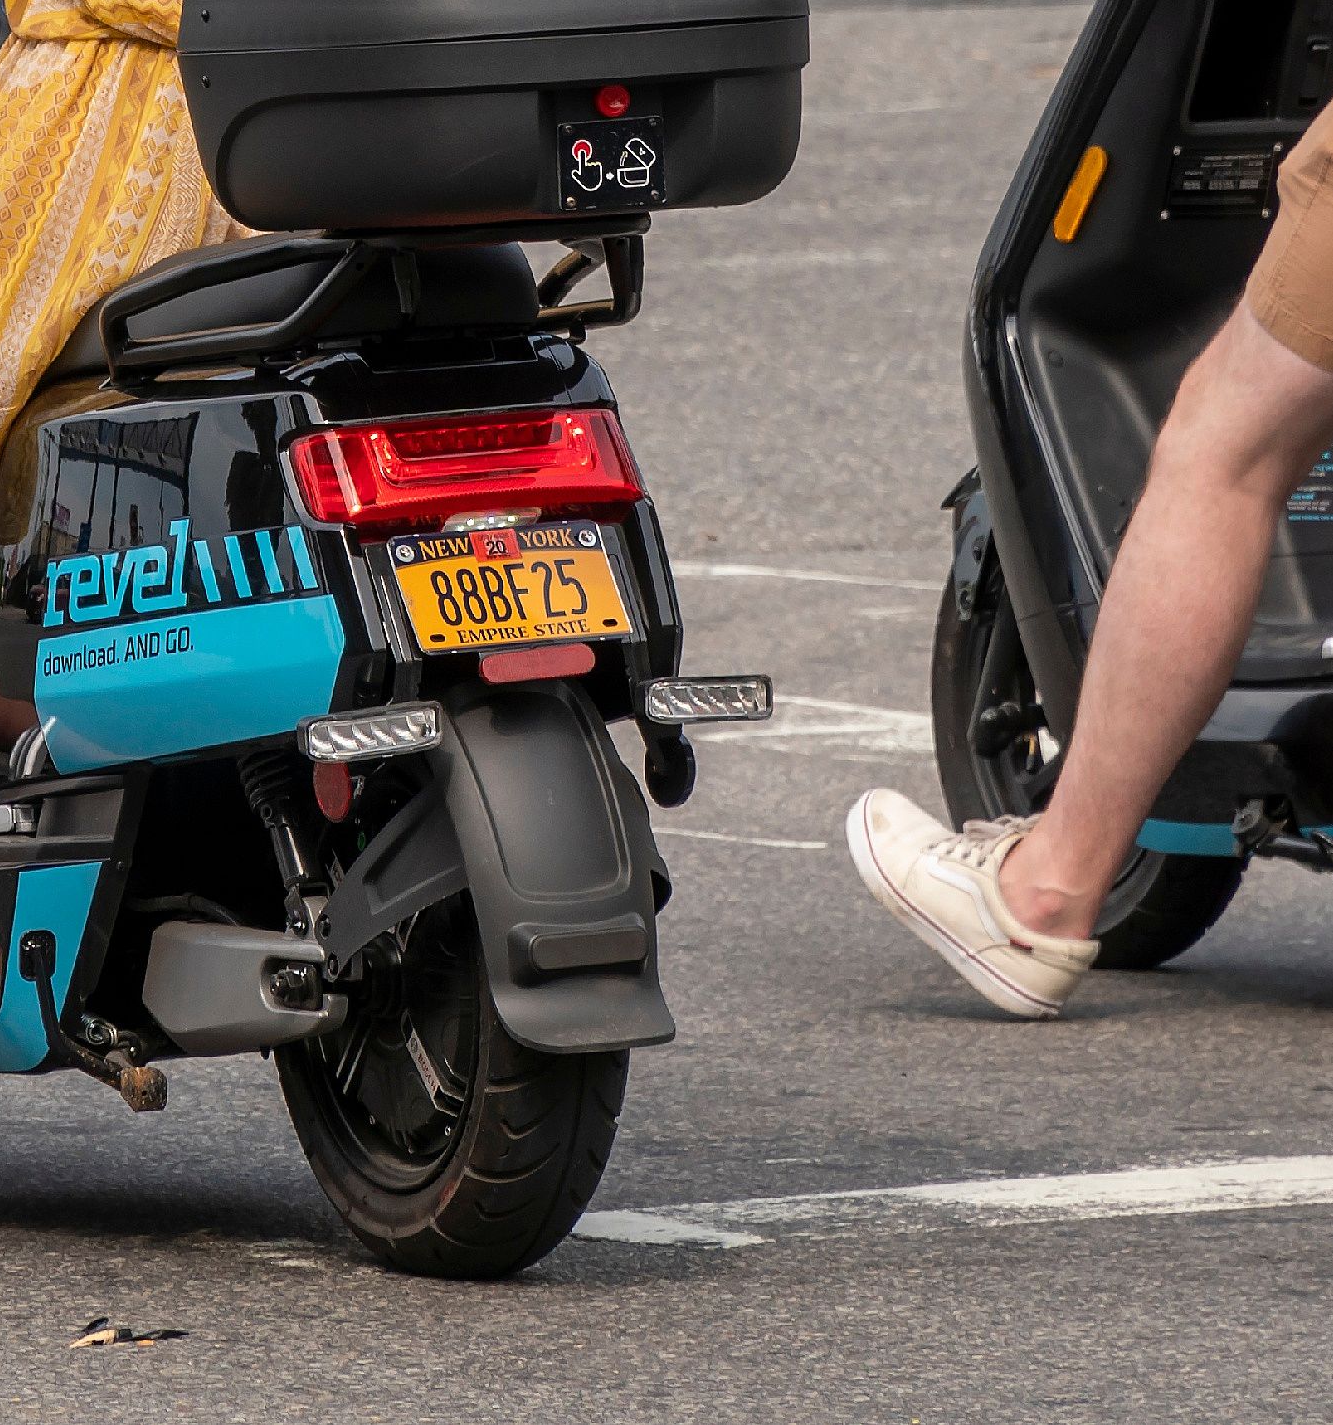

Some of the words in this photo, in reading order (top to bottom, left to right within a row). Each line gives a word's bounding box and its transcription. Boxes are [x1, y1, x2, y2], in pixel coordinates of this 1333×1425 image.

[418, 537, 470, 561] NEW
[518, 528, 575, 548] YORK
[42, 517, 190, 628] revel
[430, 559, 588, 627] 88BF25
[43, 639, 121, 677] download.
[124, 631, 160, 663] AND
[165, 626, 195, 654] GO.
[456, 625, 530, 644] EMPIRE
[533, 619, 590, 637] STATE
